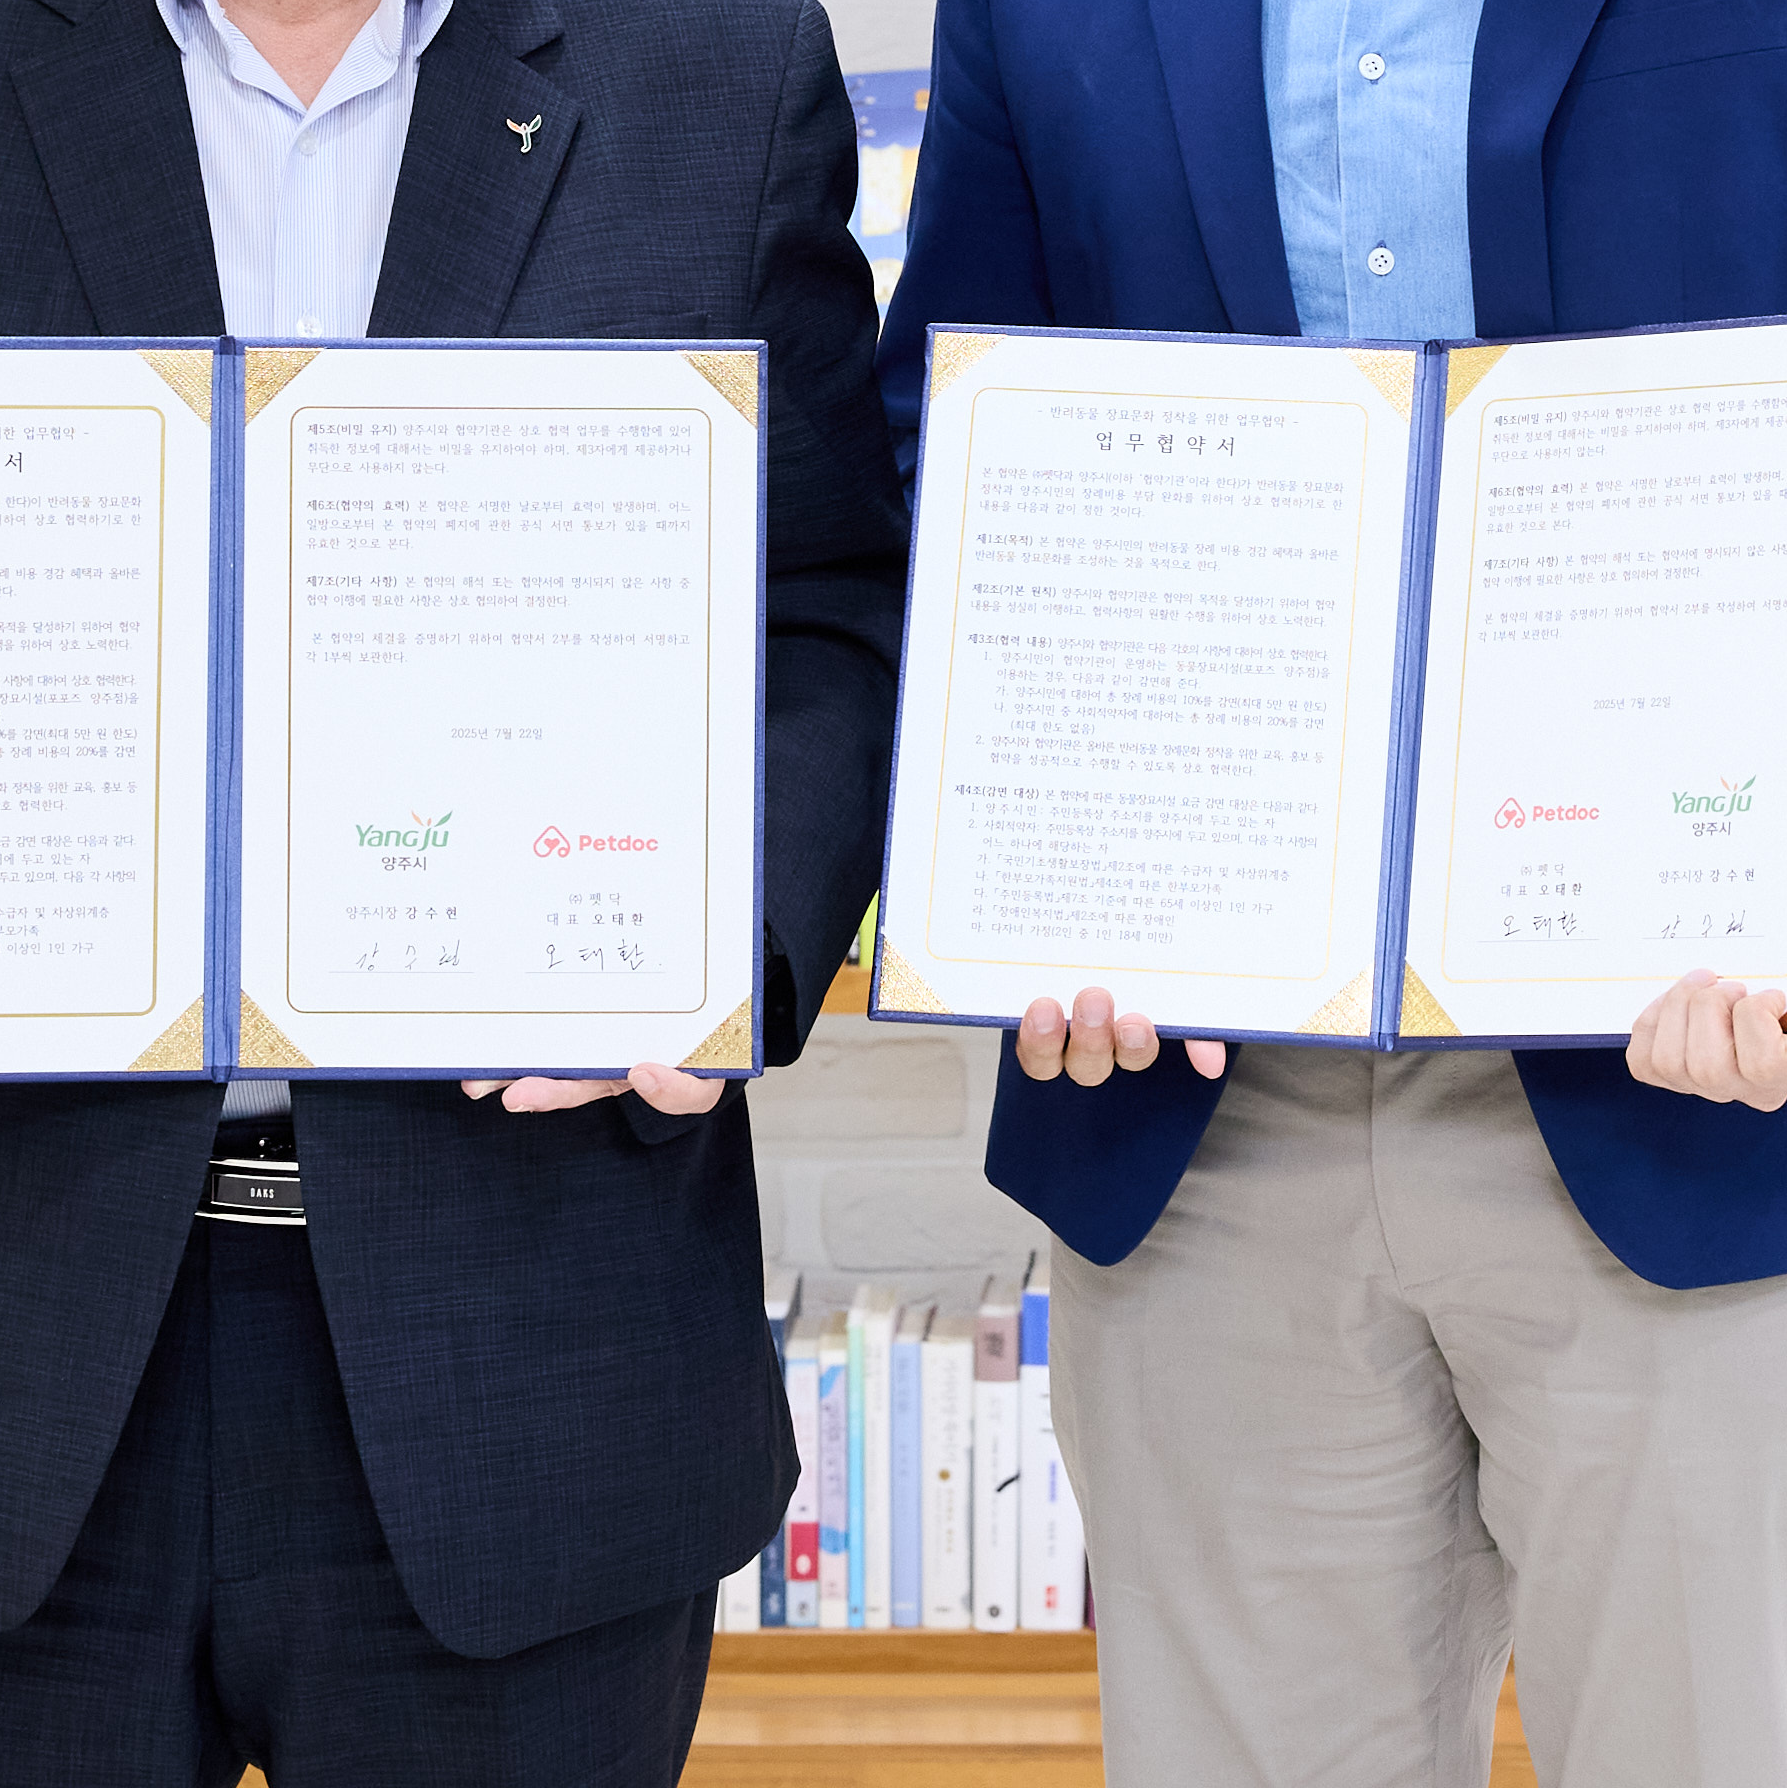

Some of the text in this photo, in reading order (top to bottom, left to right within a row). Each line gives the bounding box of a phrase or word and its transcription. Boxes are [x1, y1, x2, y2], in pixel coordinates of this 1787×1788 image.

[23, 426, 75, 441] 업무협약
[402, 423, 449, 437] 양주시와
[455, 423, 512, 437] 협약기관은
[518, 424, 542, 437] 상호
[548, 424, 570, 437] 협력
[576, 424, 611, 437] 업무를
[617, 424, 663, 438] 수행함에
[669, 424, 691, 438] 있어
[307, 442, 340, 455] 취득한
[346, 442, 381, 456] 정보에
[387, 442, 433, 456] 대해서는
[439, 442, 474, 456] 비밀을
[479, 443, 537, 456] 유지하여야
[575, 443, 628, 456] 제3자에게
[634, 443, 692, 457] 제공하거나
[307, 461, 354, 474] 무단으로
[359, 461, 405, 475] 사용하지
[47, 495, 93, 509] 반려동물
[97, 495, 142, 509] 장묘문화
[34, 513, 58, 527] 상호
[65, 513, 124, 527] 협력하기로
[130, 513, 141, 527] 한
[15, 567, 38, 581] 비용
[43, 567, 66, 581] 경감
[70, 567, 104, 580] 혜택과
[108, 567, 141, 581] 올바른
[450, 727, 543, 741] 2025년 7월 22일
[1532, 804, 1600, 822] Petdoc
[1692, 821, 1732, 837] 양주시
[578, 834, 660, 852] Petdoc
[381, 856, 428, 872] 양주시
[345, 905, 398, 920] 양주시장
